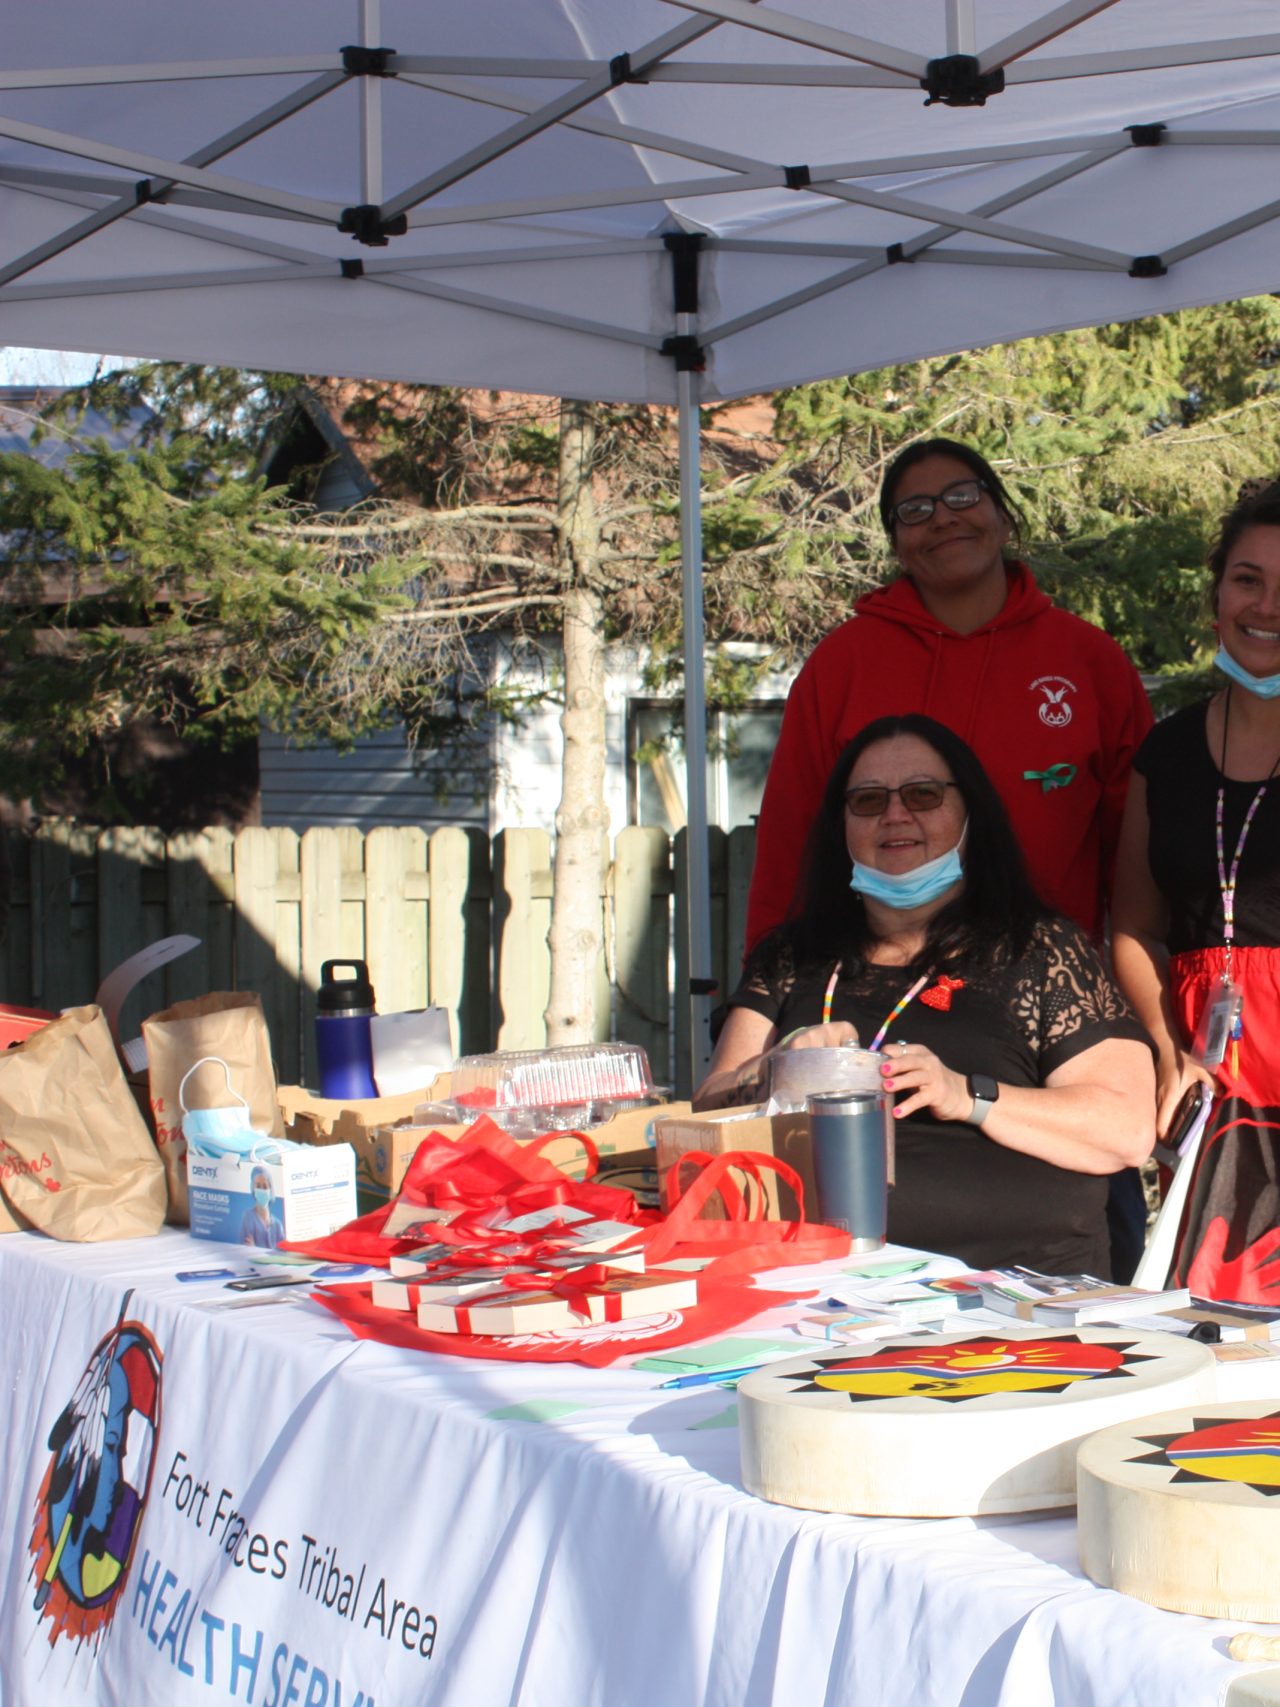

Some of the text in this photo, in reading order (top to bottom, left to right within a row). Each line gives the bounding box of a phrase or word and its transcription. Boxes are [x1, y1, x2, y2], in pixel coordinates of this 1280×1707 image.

[132, 1549, 375, 1707] HEALTH SER
[162, 1451, 439, 1661] Fort Fraces Tribal Area
